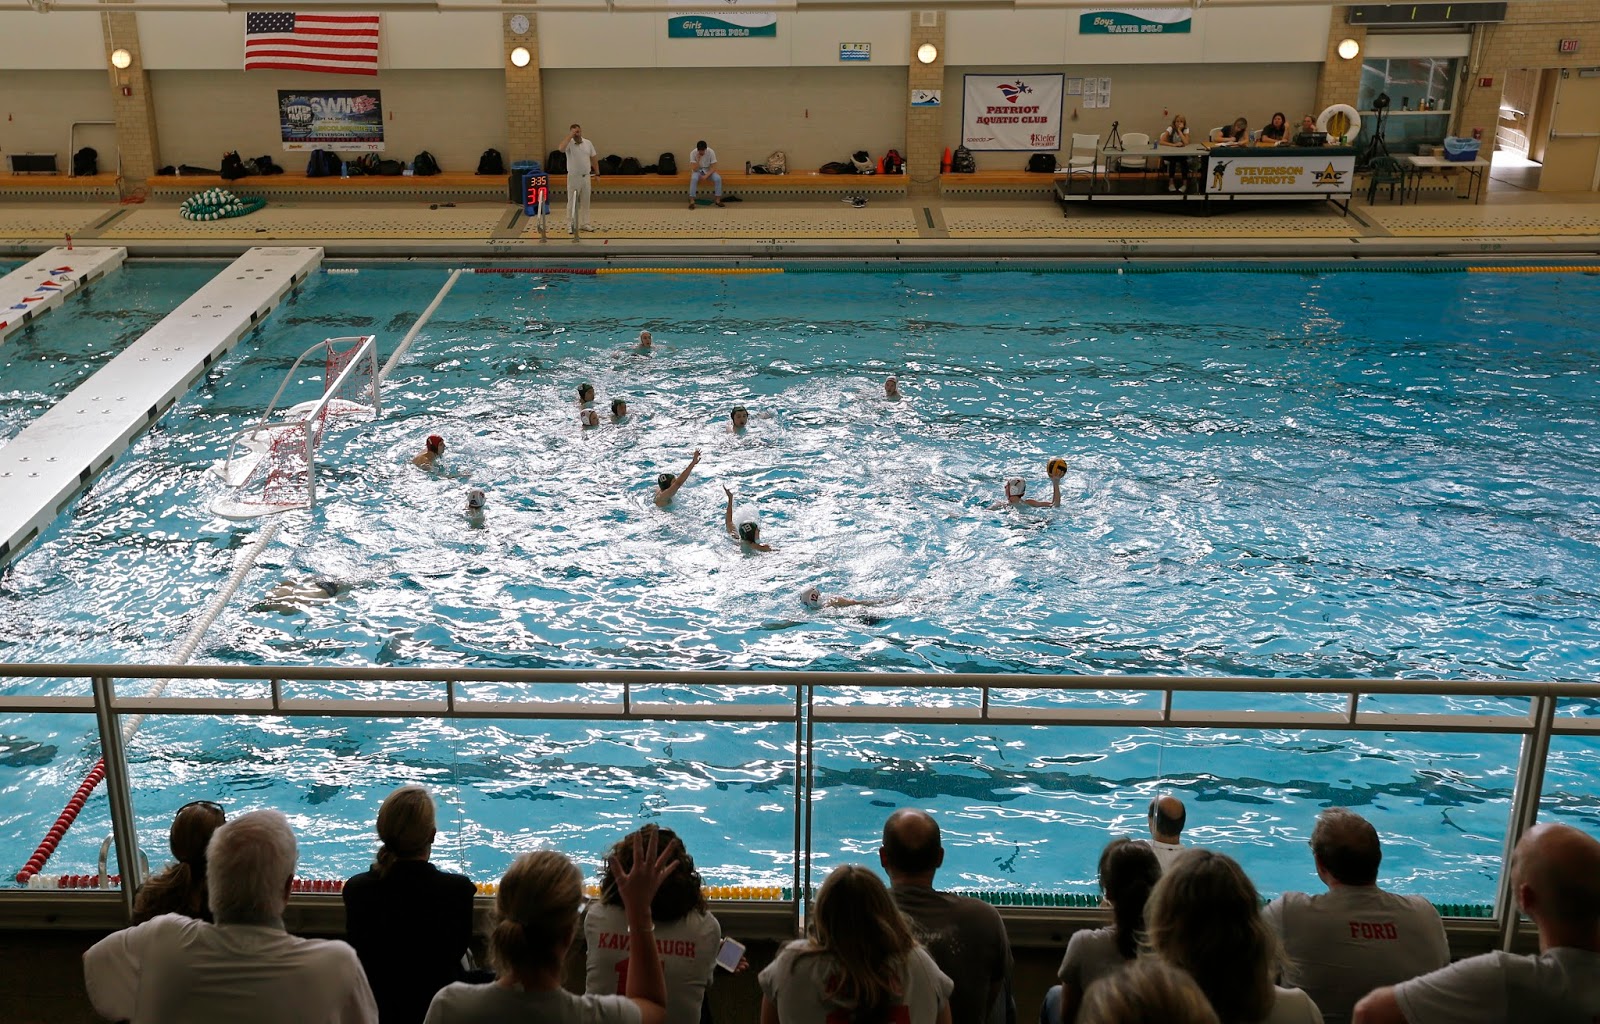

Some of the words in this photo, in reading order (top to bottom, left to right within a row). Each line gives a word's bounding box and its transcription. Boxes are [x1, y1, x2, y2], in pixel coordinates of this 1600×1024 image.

[682, 20, 702, 30] Girls
[1093, 17, 1115, 28] Boys
[695, 28, 727, 37] WATER
[728, 28, 750, 37] POLO
[1107, 25, 1140, 34] WATER
[1141, 25, 1163, 33] POLO
[1562, 40, 1578, 51] EXIT
[986, 106, 1040, 115] PATRIOT
[976, 116, 1019, 125] AQUATIC
[1020, 116, 1048, 124] CLUB
[1035, 133, 1056, 142] Kiefer
[1234, 166, 1304, 176] STEVENSON
[1240, 176, 1296, 185] PATRIOTS
[1315, 172, 1343, 180] PAC
[530, 176, 547, 187] 3:35
[659, 475, 667, 483] 10
[810, 593, 819, 602] 12
[1349, 921, 1399, 940] FORD
[598, 932, 697, 959] KAVAUGH
